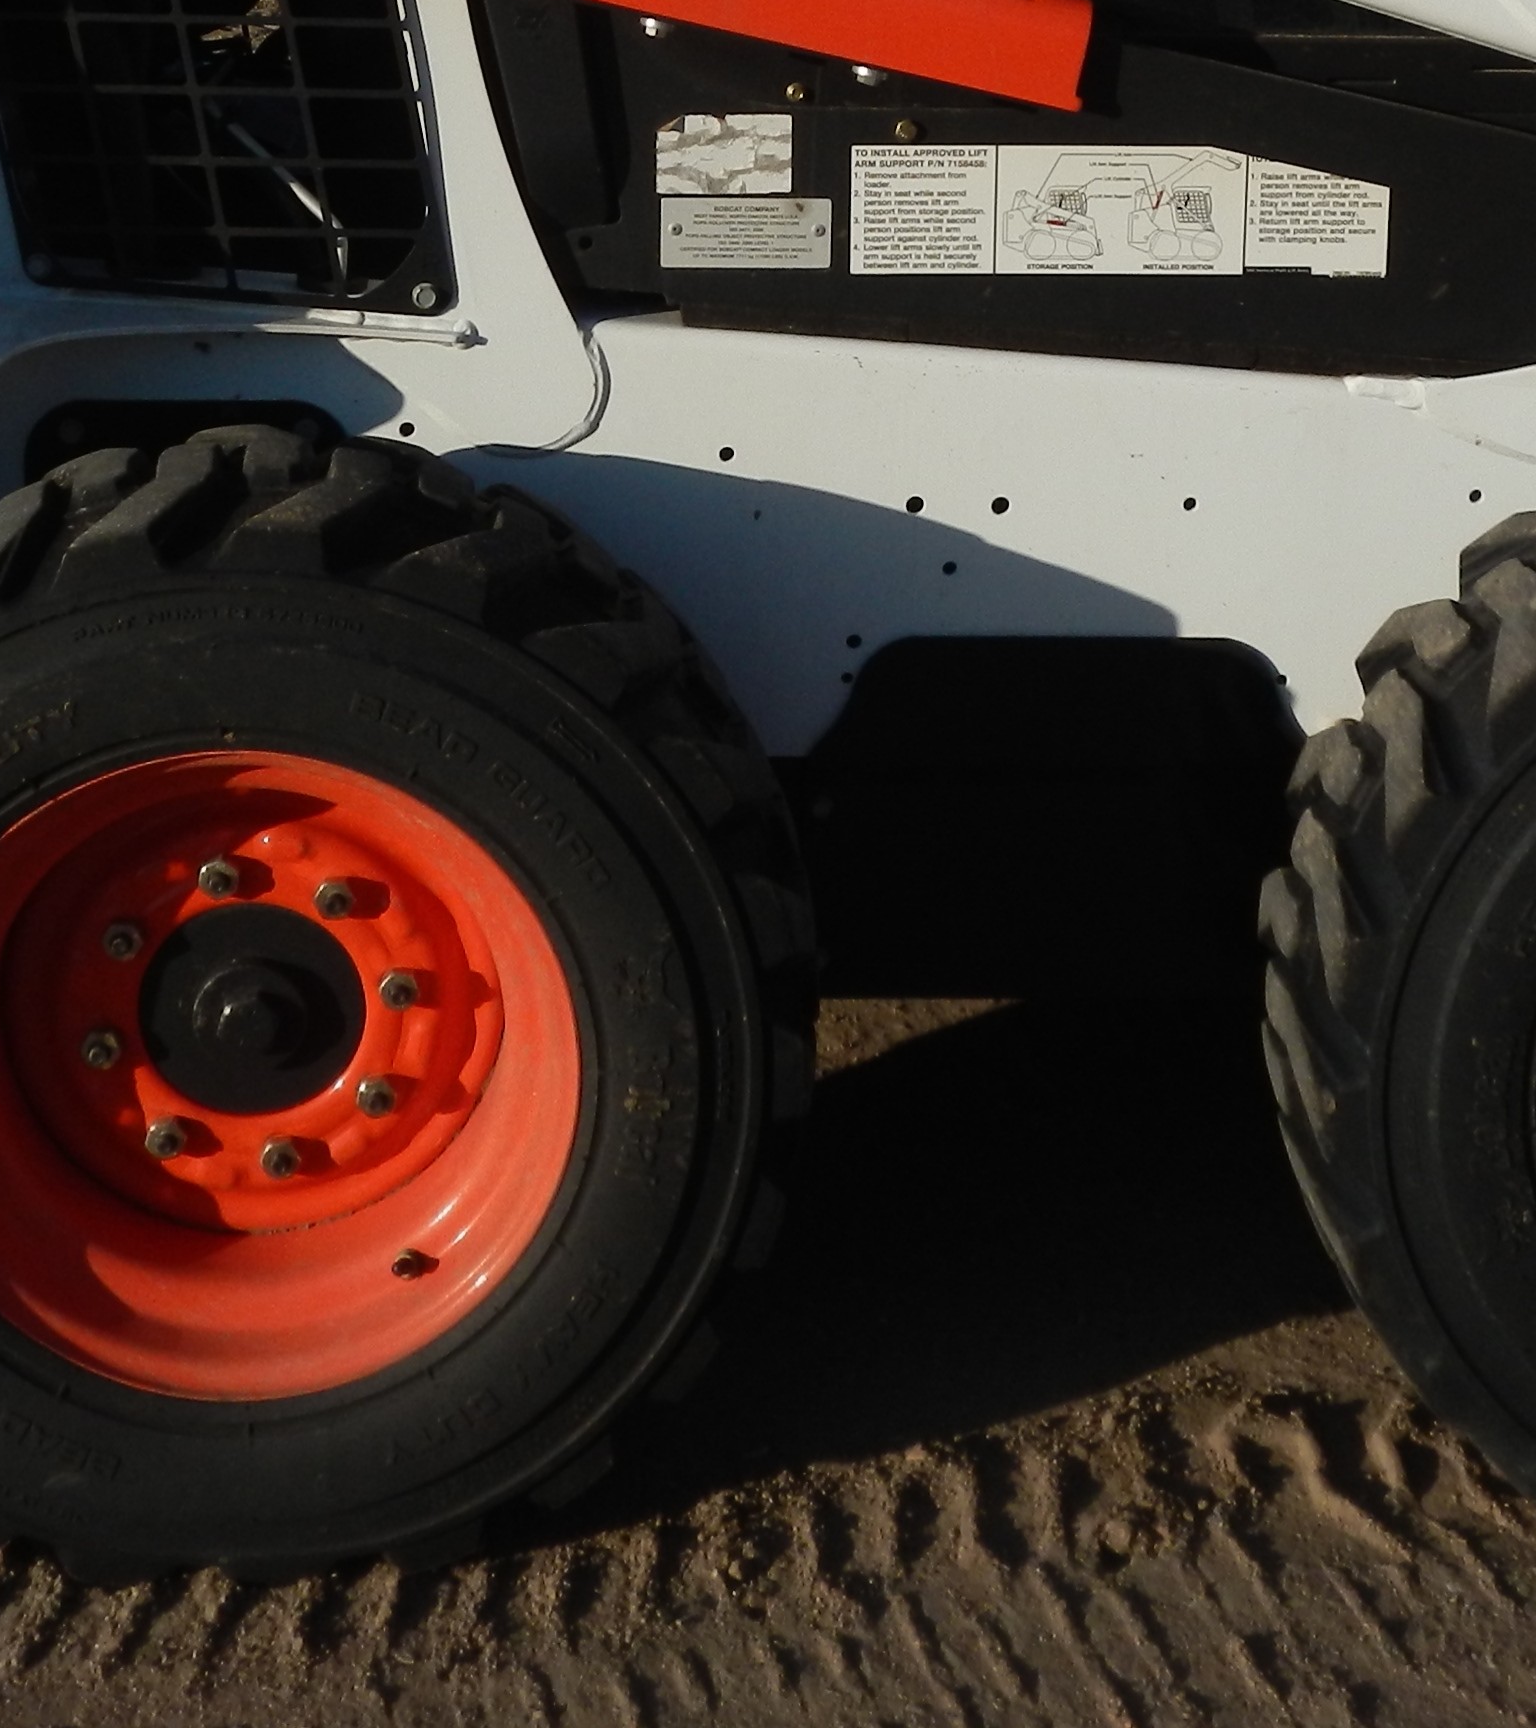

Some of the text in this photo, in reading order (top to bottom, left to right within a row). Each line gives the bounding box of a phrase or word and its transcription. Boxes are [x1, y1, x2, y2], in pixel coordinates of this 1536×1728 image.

[870, 149, 910, 157] INSTALL
[913, 149, 966, 157] APPROVED
[968, 149, 988, 157] LIFT
[879, 160, 925, 168] SUPPORT
[864, 190, 882, 198] Stay
[1317, 191, 1351, 200] cylinder
[1260, 200, 1278, 209] Stay
[864, 208, 895, 217] support
[919, 208, 949, 216] storage
[1322, 218, 1355, 226] support
[894, 226, 931, 234] positions
[1259, 227, 1291, 236] storage
[1293, 227, 1327, 235] position
[864, 235, 895, 243] support
[897, 235, 927, 243] against
[928, 235, 961, 243] cylinder
[1278, 236, 1317, 245] clamping
[925, 244, 950, 252] slowly
[881, 253, 912, 262] support
[943, 253, 977, 261] securely
